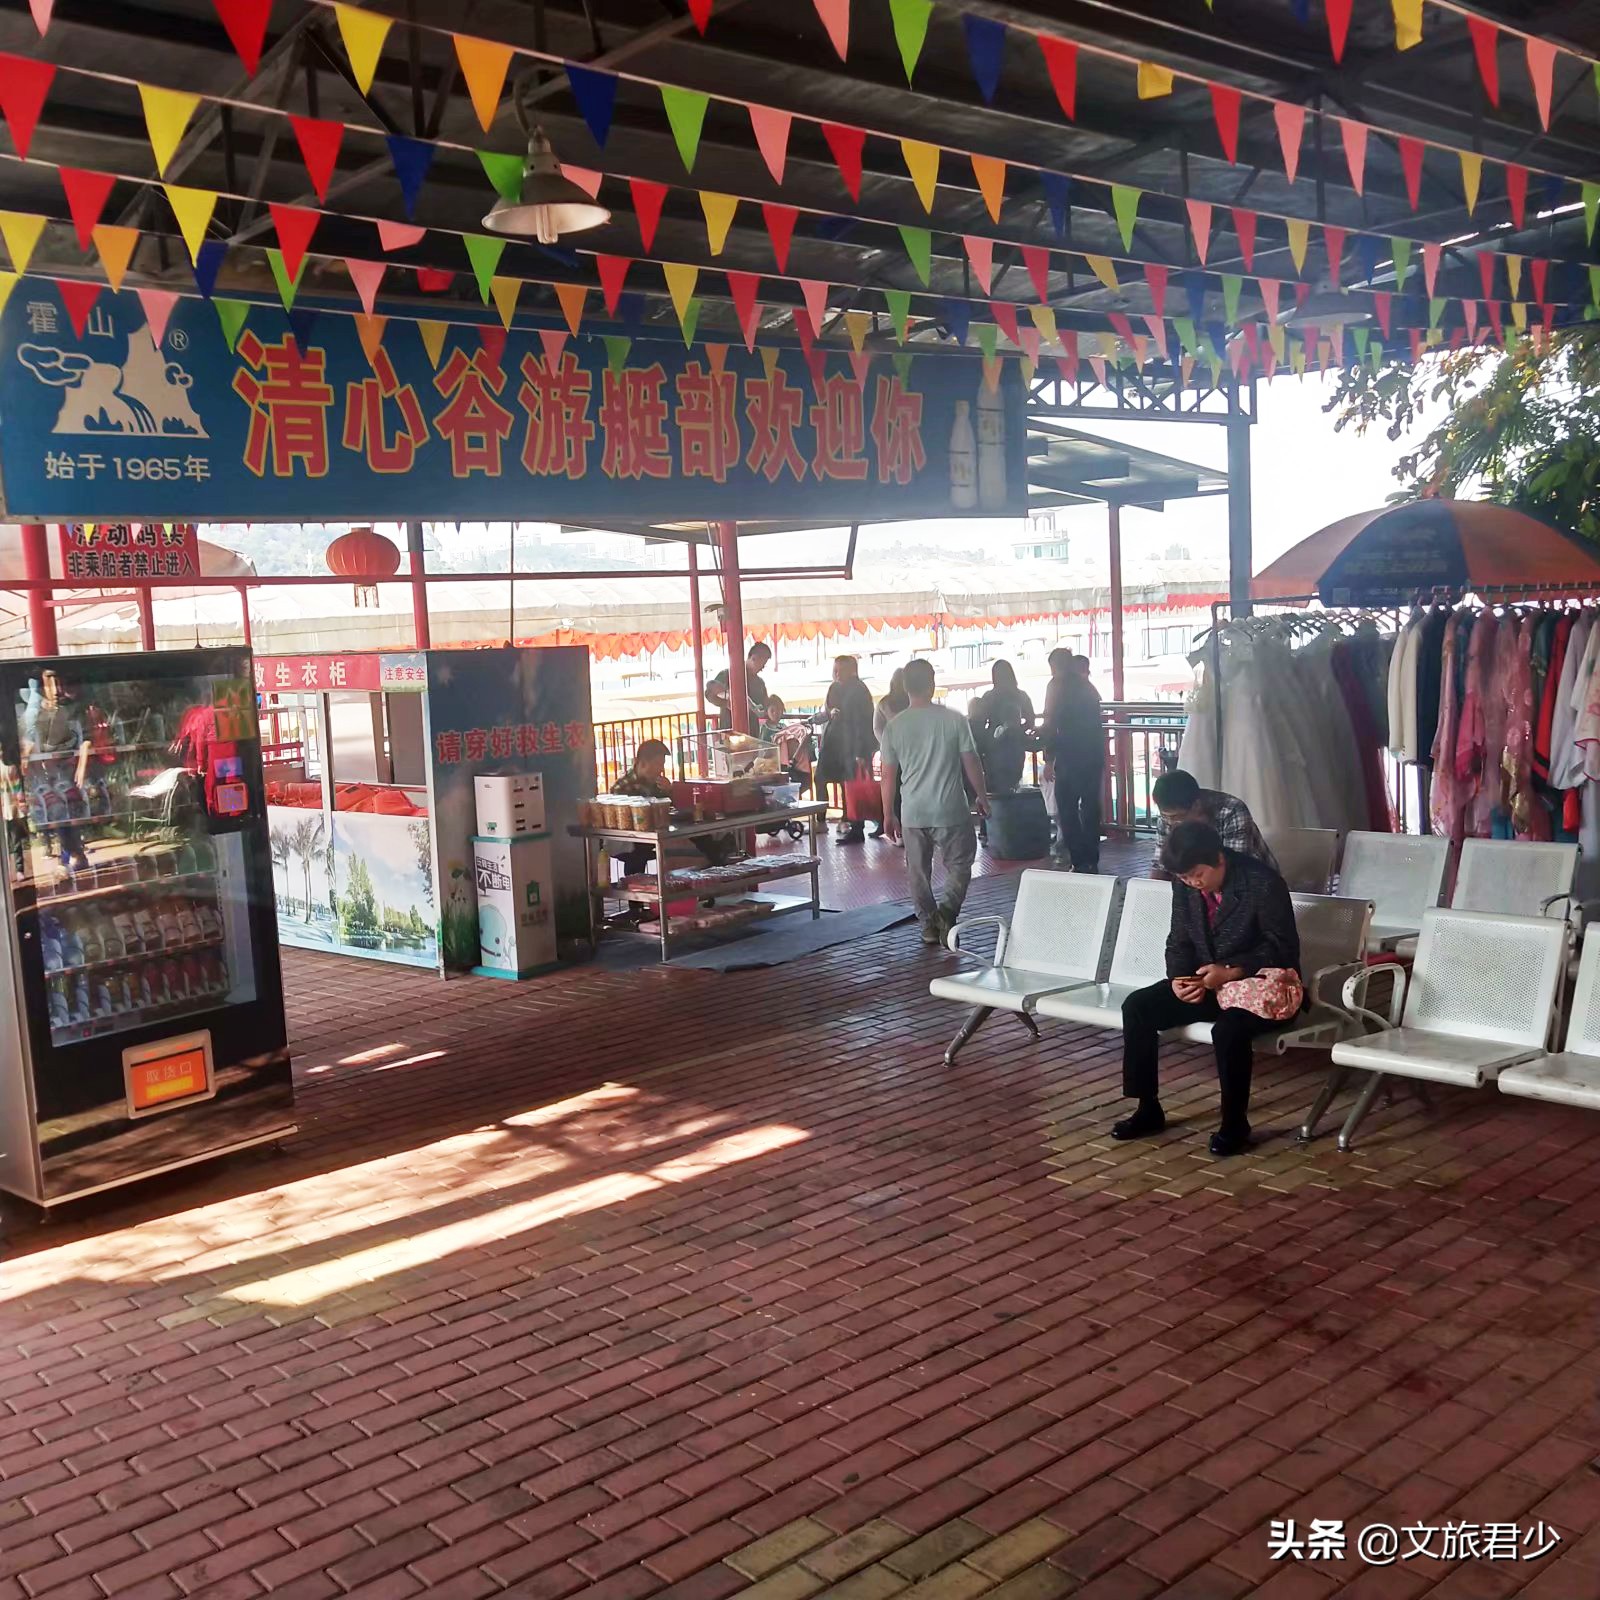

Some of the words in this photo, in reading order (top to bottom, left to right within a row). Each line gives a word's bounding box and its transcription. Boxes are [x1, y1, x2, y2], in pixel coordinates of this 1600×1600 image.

[27, 301, 114, 338] 霍山
[232, 329, 926, 484] 清心谷游艇部欢迎你
[45, 451, 211, 482] 始于1965年
[68, 551, 195, 577] 非乘船者禁止进入
[384, 666, 425, 681] 注意安全
[435, 720, 586, 763] 请穿好救生衣
